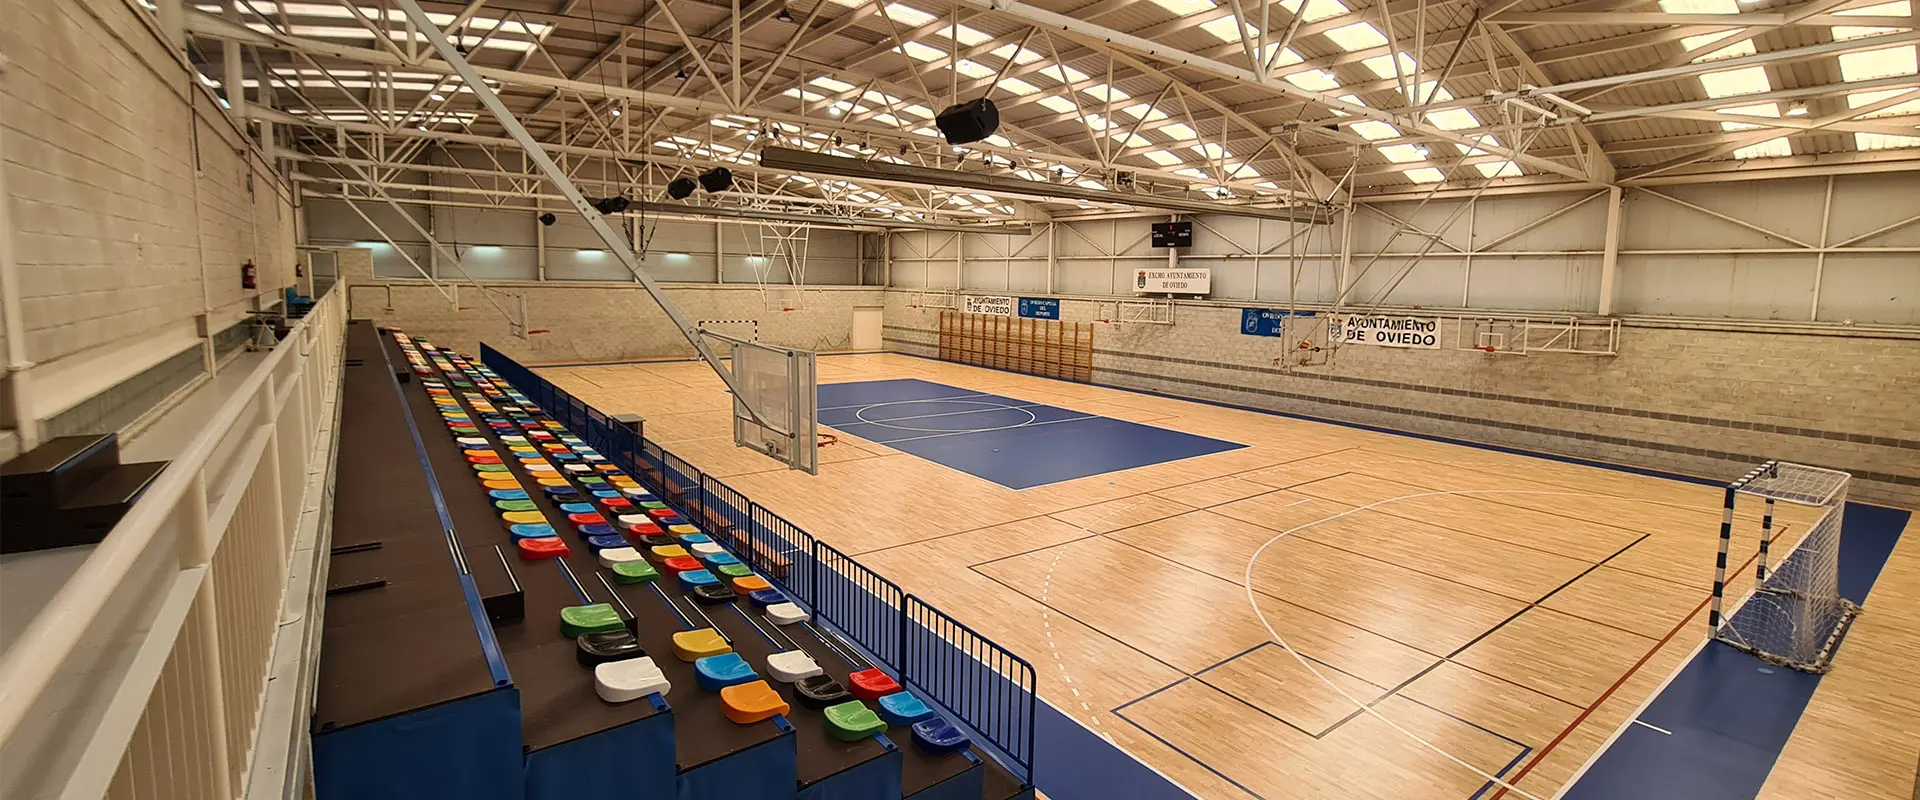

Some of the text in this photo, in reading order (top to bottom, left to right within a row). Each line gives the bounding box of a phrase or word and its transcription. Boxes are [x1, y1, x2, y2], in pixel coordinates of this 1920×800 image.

[973, 297, 1009, 305] AYUNTAMIENTO
[985, 305, 1009, 314] OVIEDO
[1347, 316, 1436, 333] AYUNTAMIENTO
[1346, 329, 1436, 346] DE OVIEDO
